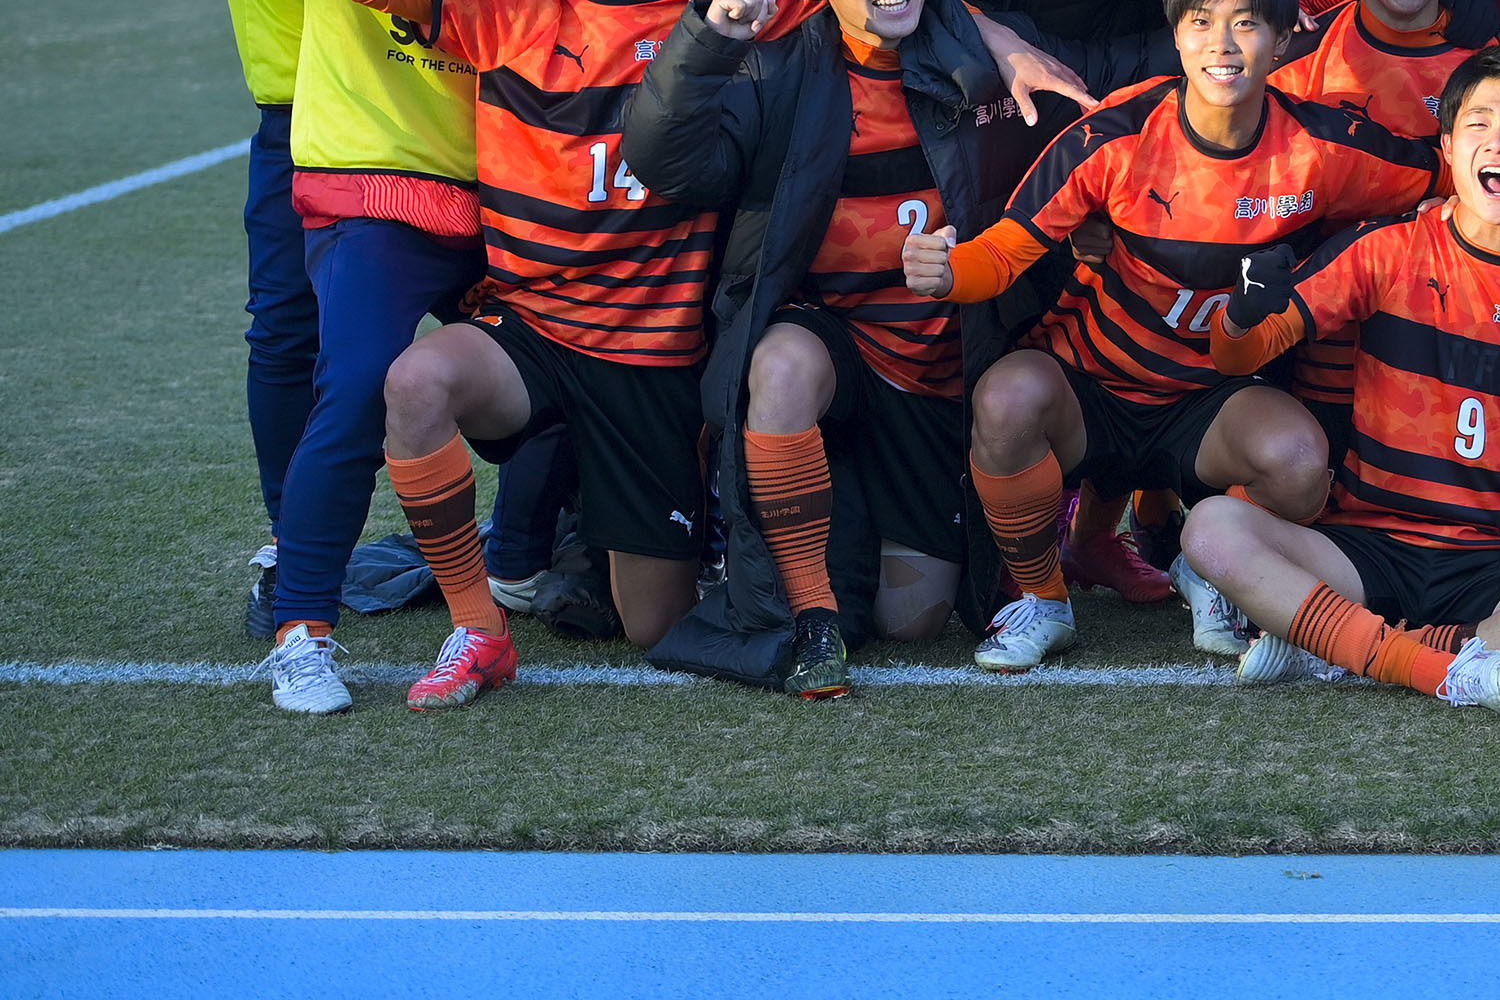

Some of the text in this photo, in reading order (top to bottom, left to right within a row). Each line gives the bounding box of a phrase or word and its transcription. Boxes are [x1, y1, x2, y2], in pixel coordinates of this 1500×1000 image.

[387, 49, 415, 67] FOR
[420, 57, 445, 72] THE
[588, 141, 649, 202] 14
[1454, 396, 1488, 460] 9
